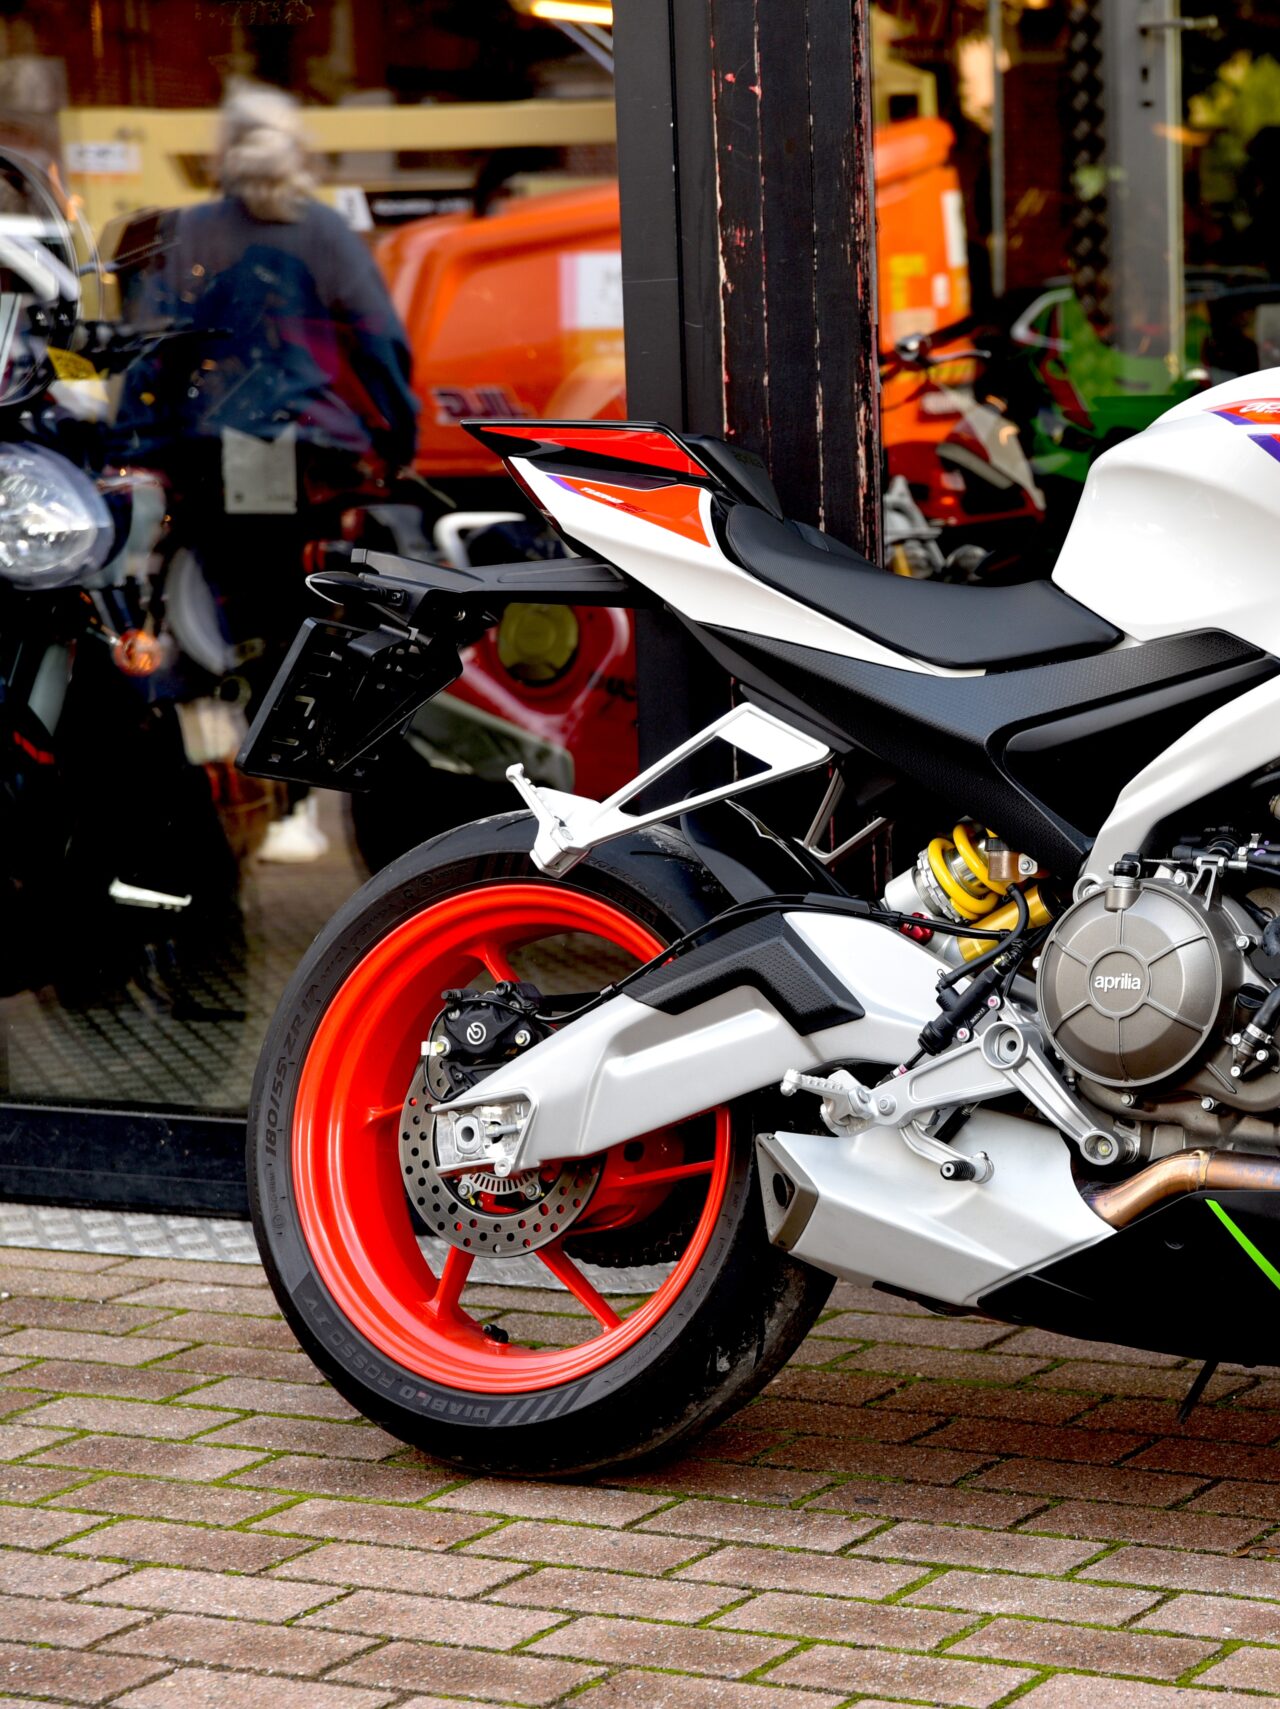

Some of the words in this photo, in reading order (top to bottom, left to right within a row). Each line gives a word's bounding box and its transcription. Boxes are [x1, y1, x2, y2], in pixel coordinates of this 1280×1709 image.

[1094, 972, 1141, 993] aprilia
[328, 1330, 395, 1390] ROSSO
[400, 1383, 492, 1422] DIABLO
